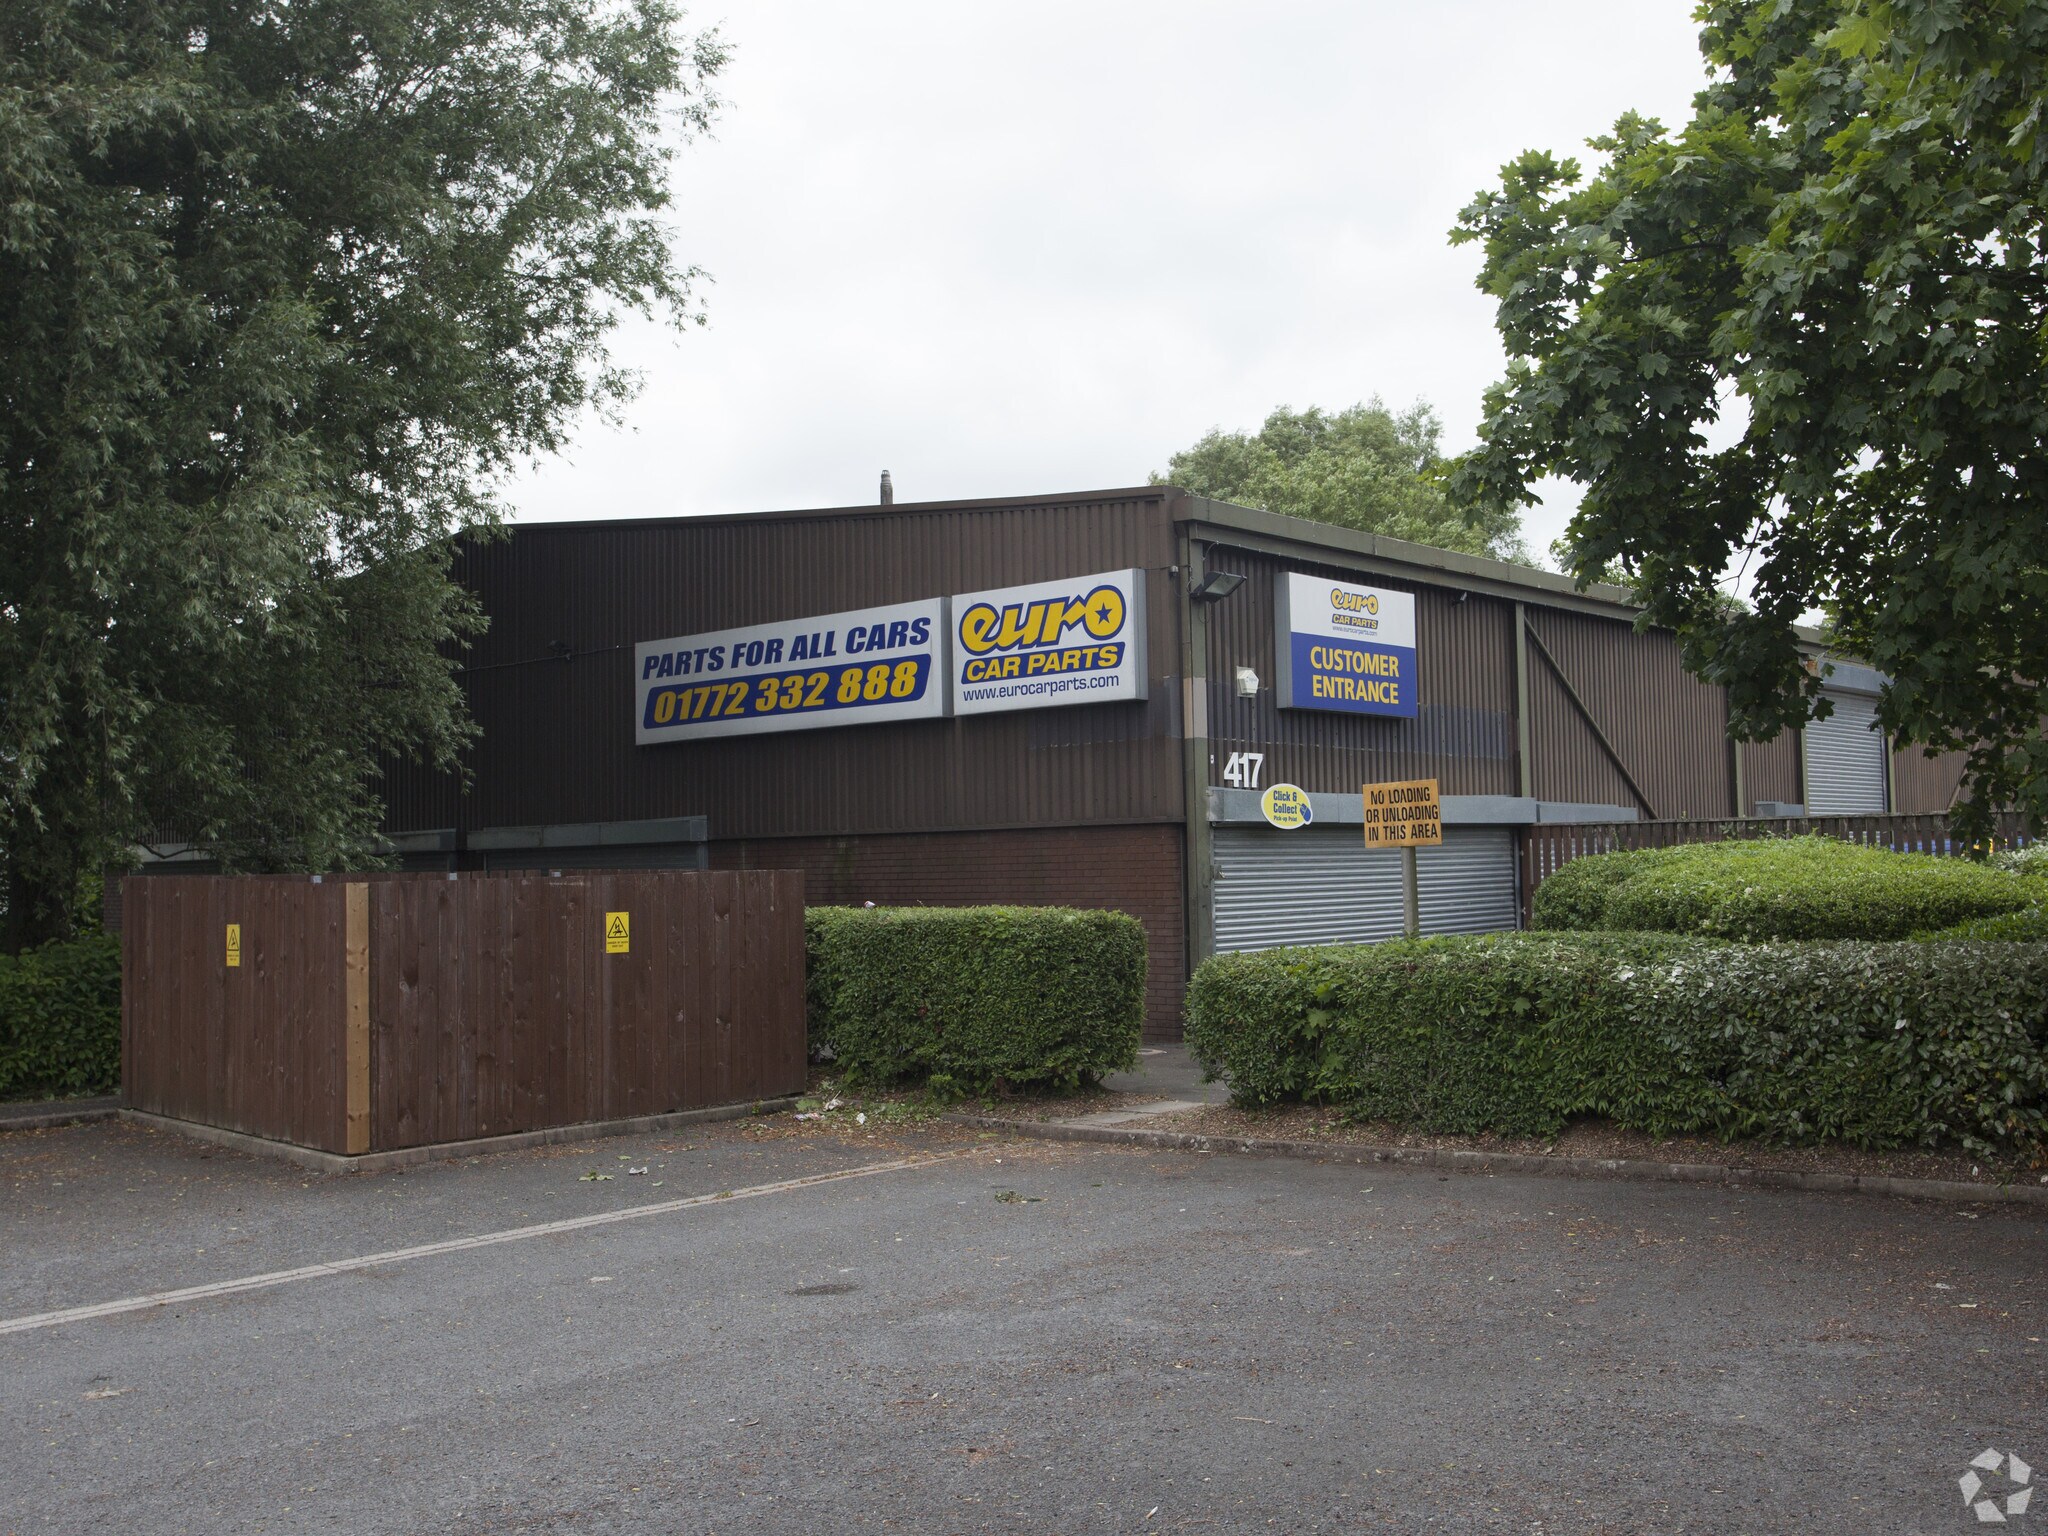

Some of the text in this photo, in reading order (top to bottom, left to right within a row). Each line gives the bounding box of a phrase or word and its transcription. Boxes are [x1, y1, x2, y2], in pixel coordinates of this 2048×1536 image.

[1331, 588, 1378, 615] euro
[959, 585, 1126, 656] euro
[1333, 614, 1377, 629] CAR PARTS
[642, 617, 931, 680] PARTS FOR ALL CARS
[1310, 646, 1400, 677] CUSTOMER
[966, 645, 1118, 681] CAR PARTS
[654, 661, 918, 723] 01772 332 888
[963, 674, 1120, 701] www.eurocarparts.com
[1312, 674, 1399, 704] ENTRANCE
[1224, 752, 1264, 788] 417
[1273, 790, 1298, 802] Click &
[1273, 803, 1298, 814] Collect
[1370, 787, 1431, 805] NO LOADING
[1366, 804, 1439, 823] OR UNLOADING
[1368, 823, 1438, 841] IN THIS AREA
